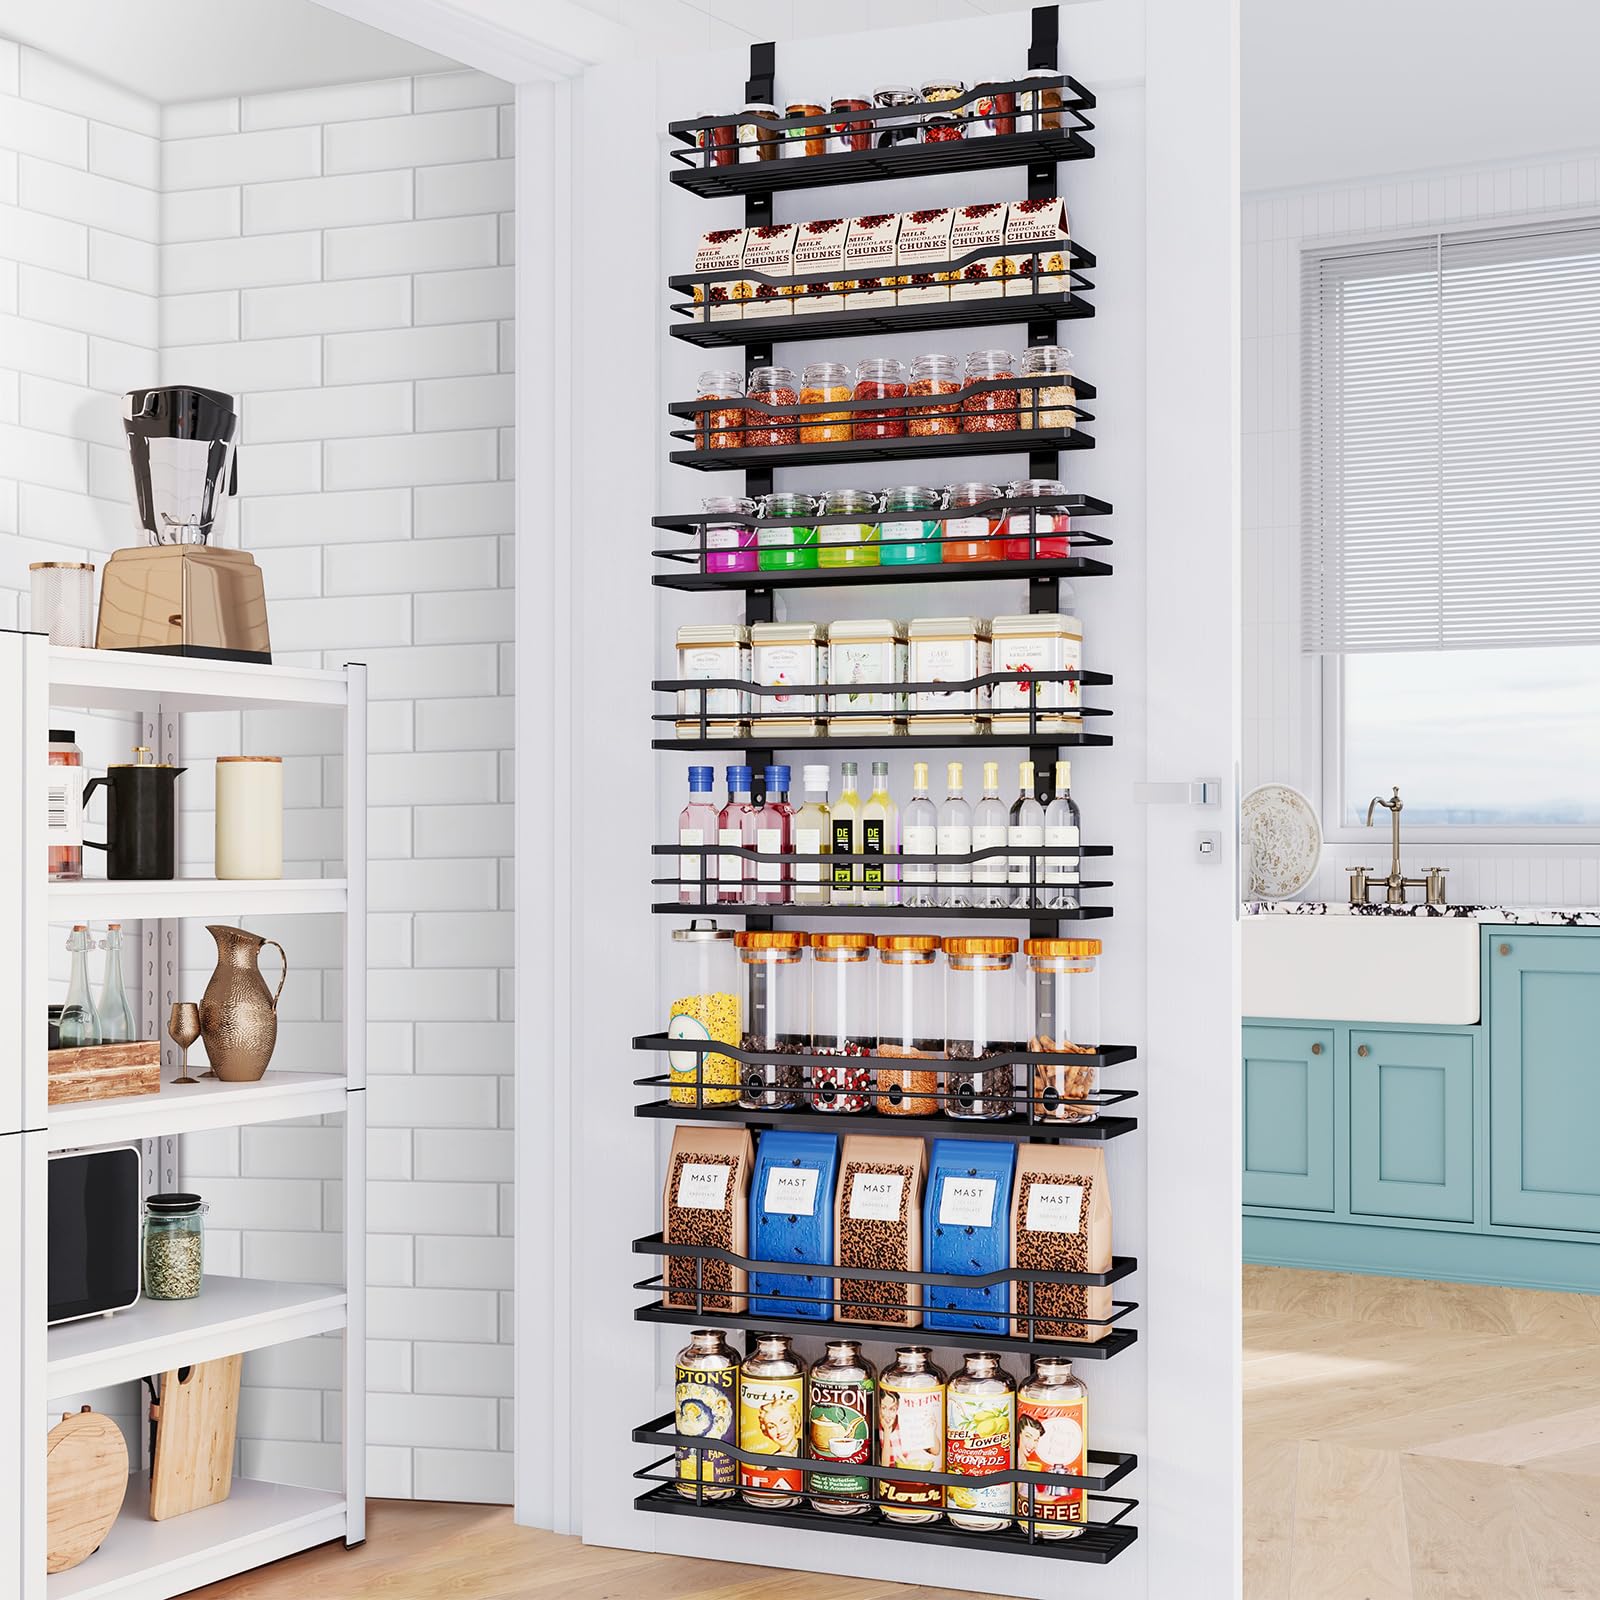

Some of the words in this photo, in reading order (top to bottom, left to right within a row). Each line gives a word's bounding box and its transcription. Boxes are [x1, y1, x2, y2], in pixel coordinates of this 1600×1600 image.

[1007, 223, 1057, 233] CHOCOLATE
[1008, 220, 1034, 228] MILK
[952, 229, 1000, 238] CHOCOLATE
[954, 225, 979, 233] MILK
[900, 234, 946, 243] CHOCOLATE
[901, 230, 926, 238] MILK
[1007, 229, 1056, 240] CHUNKS
[847, 239, 893, 248] CHOCOLATE
[848, 235, 873, 243] MILK
[952, 234, 1000, 246] CHUNKS
[796, 244, 841, 252] CHOCOLATE
[797, 240, 822, 248] MILK
[899, 239, 947, 250] CHUNKS
[745, 249, 790, 258] CHOCOLATE
[746, 245, 770, 253] MILK
[846, 244, 893, 256] CHUNKS
[695, 254, 740, 262] CHOCOLATE
[697, 250, 721, 258] MILK
[795, 249, 842, 260] CHUNKS
[744, 254, 790, 265] CHUNKS
[695, 259, 740, 270] CHUNKS
[836, 828, 849, 837] DE
[867, 828, 880, 837] DE
[691, 1174, 718, 1183] MAST
[778, 1178, 807, 1187] MAST
[863, 1184, 891, 1193] MAST
[953, 1188, 984, 1198] MAST
[1040, 1195, 1071, 1205] MAST
[741, 1385, 795, 1402] Tootsie
[970, 1433, 1008, 1448] TOWER
[879, 1480, 941, 1502] Flour
